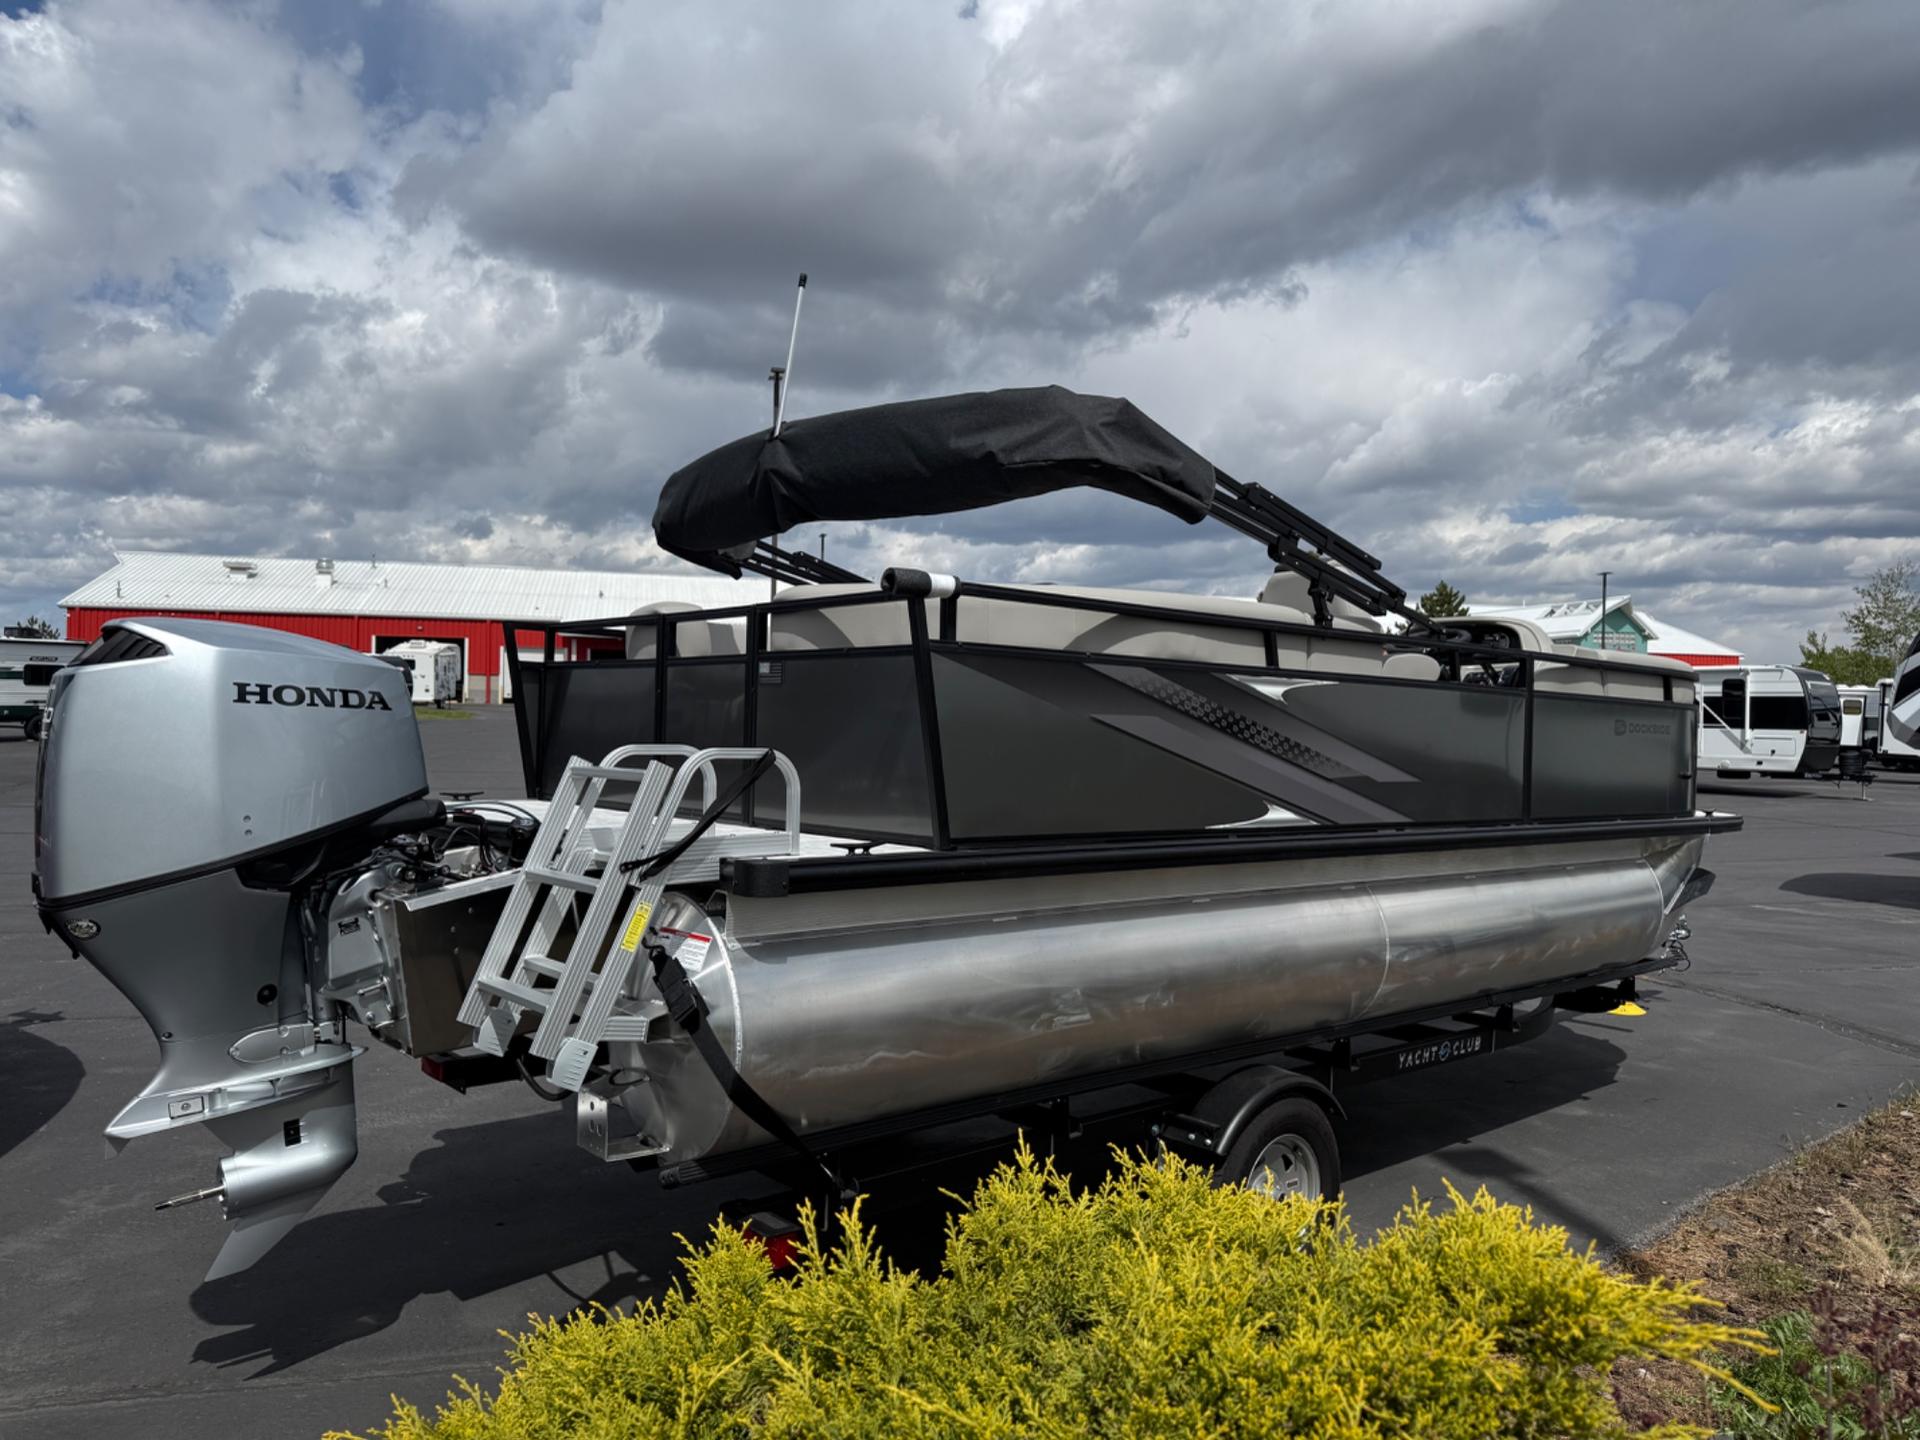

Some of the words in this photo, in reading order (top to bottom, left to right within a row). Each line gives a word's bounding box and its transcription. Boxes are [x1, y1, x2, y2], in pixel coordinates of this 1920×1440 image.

[232, 682, 393, 711] HONDA
[1399, 1046, 1438, 1069] YACHT
[1452, 1036, 1481, 1056] CLUB
